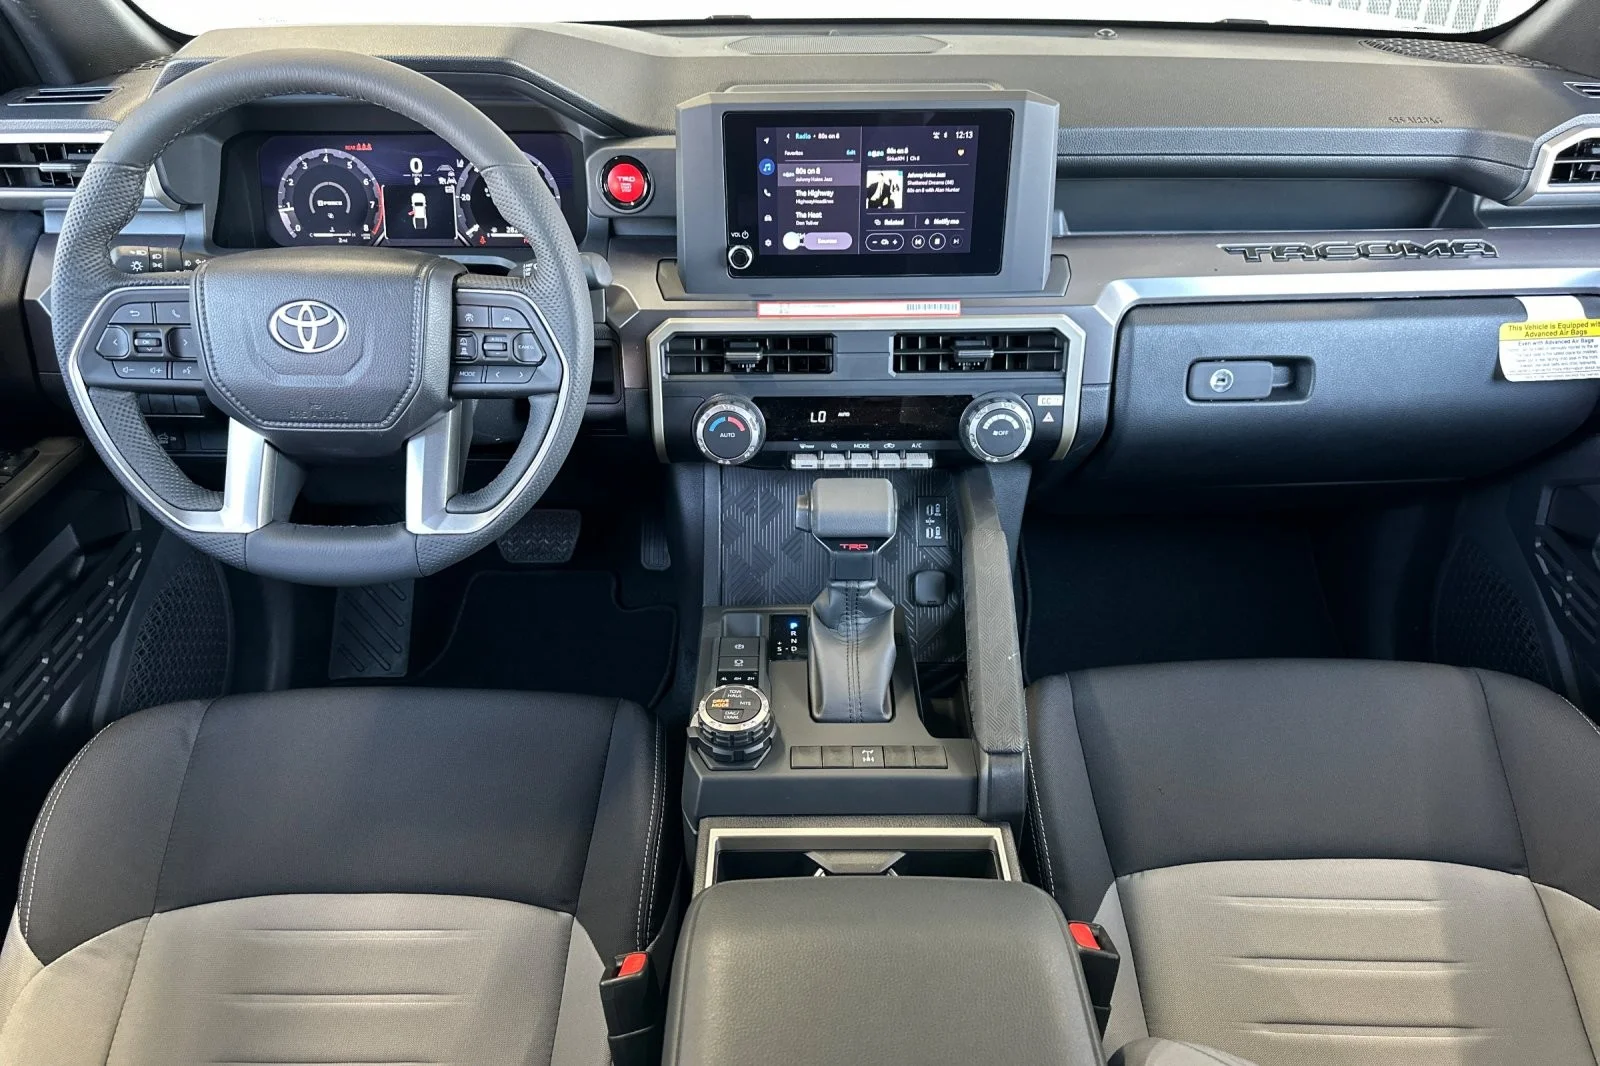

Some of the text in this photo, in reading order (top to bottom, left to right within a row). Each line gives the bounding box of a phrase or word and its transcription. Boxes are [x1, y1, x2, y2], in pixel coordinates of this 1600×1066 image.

[410, 158, 422, 173] 0
[414, 177, 420, 185] P
[808, 189, 834, 198] Highway
[934, 218, 950, 226] Notify
[1216, 239, 1499, 262] TACOMA
[1558, 321, 1588, 330] Equipped
[810, 411, 826, 423] LO
